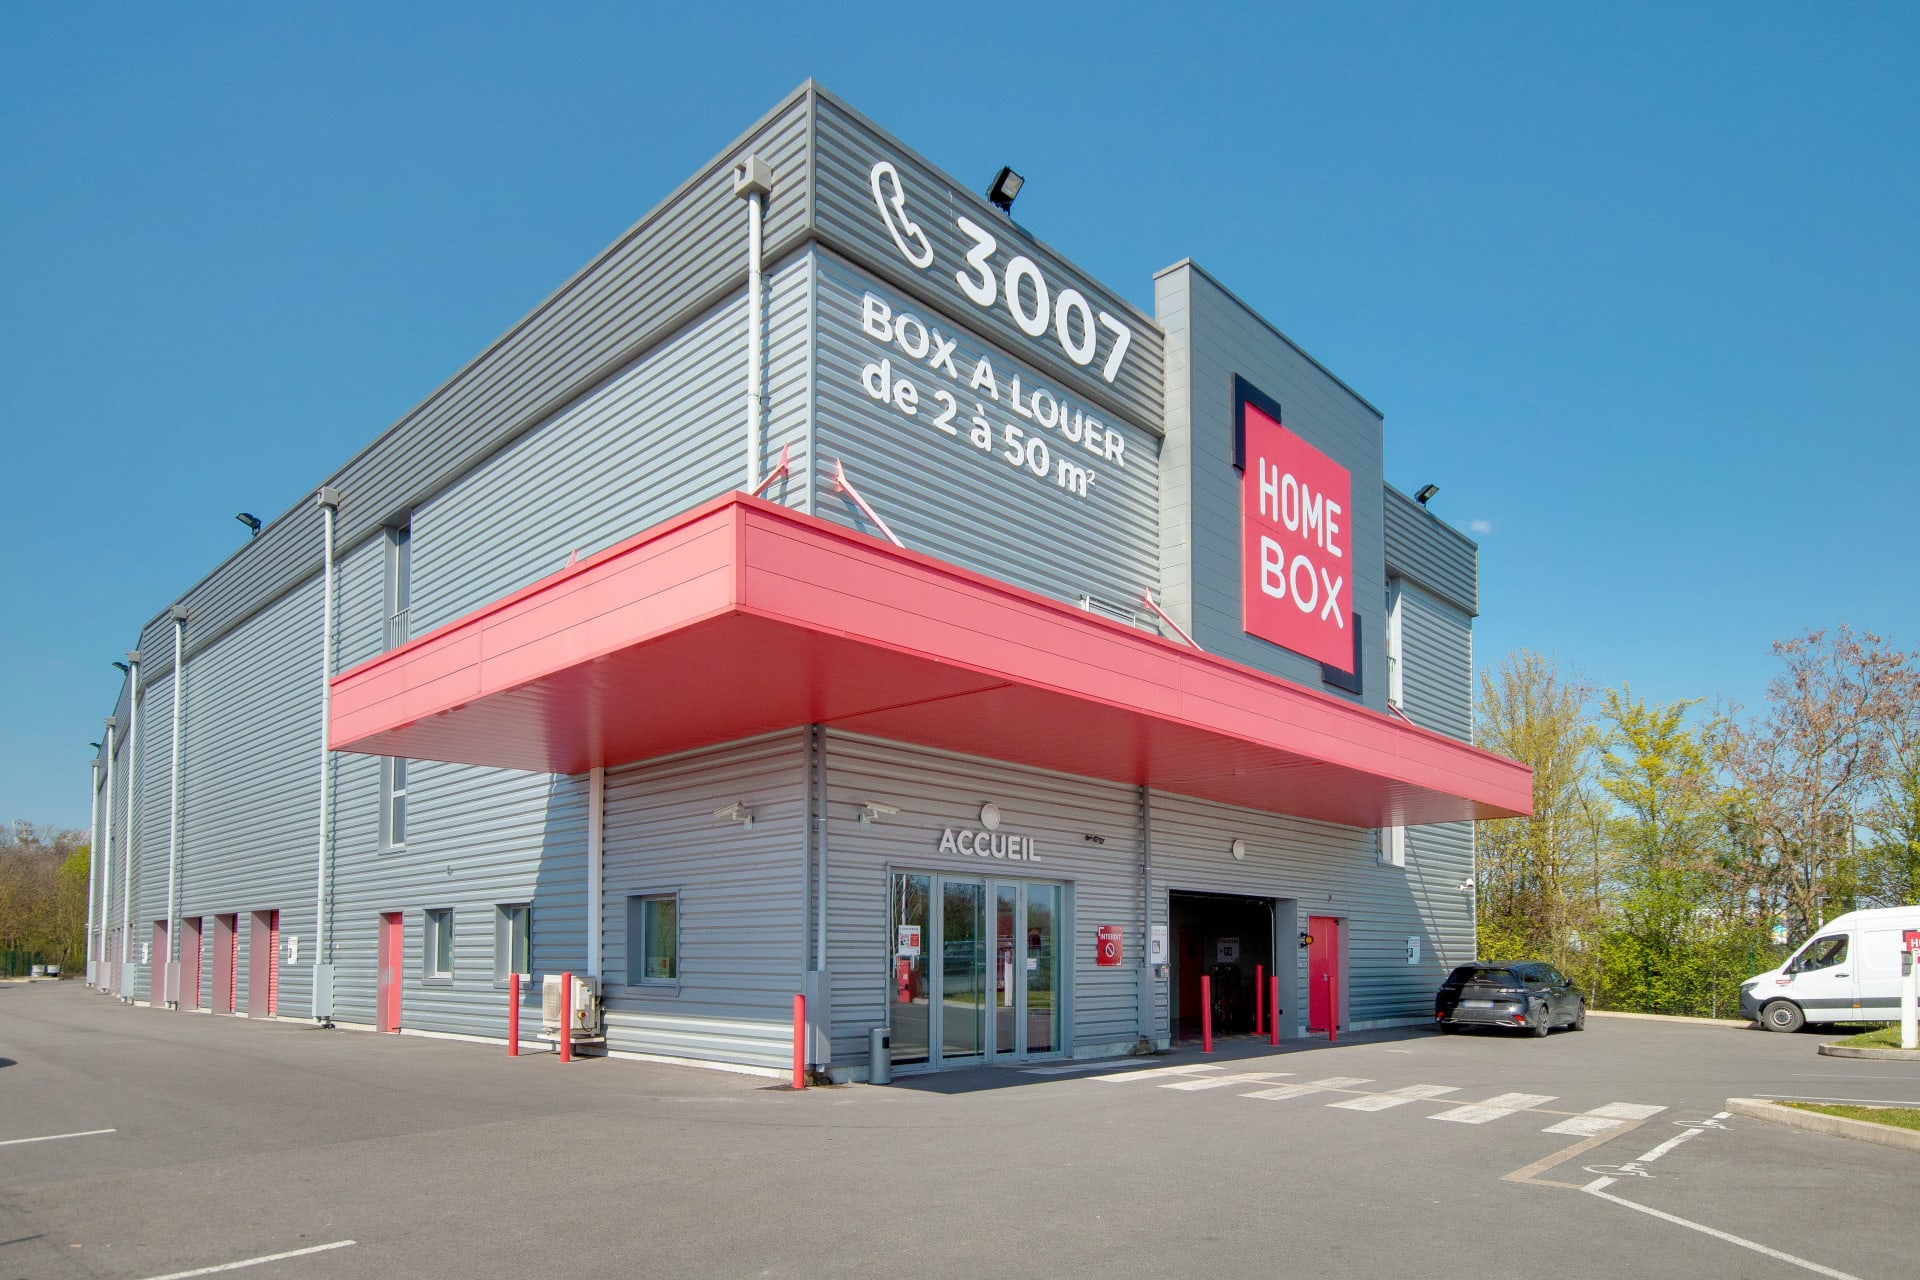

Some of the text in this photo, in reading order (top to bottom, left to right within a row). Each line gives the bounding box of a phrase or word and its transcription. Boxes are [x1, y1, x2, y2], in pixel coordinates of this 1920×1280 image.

[956, 216, 1131, 383] 3007
[862, 359, 918, 415] de
[933, 390, 957, 435] 2
[971, 404, 992, 452] à
[1004, 424, 1050, 477] 50
[864, 290, 1125, 467] BOX A LOUER
[1259, 456, 1343, 558] HOME
[1260, 535, 1344, 629] BOX
[939, 828, 1042, 862] ACCUEIL
